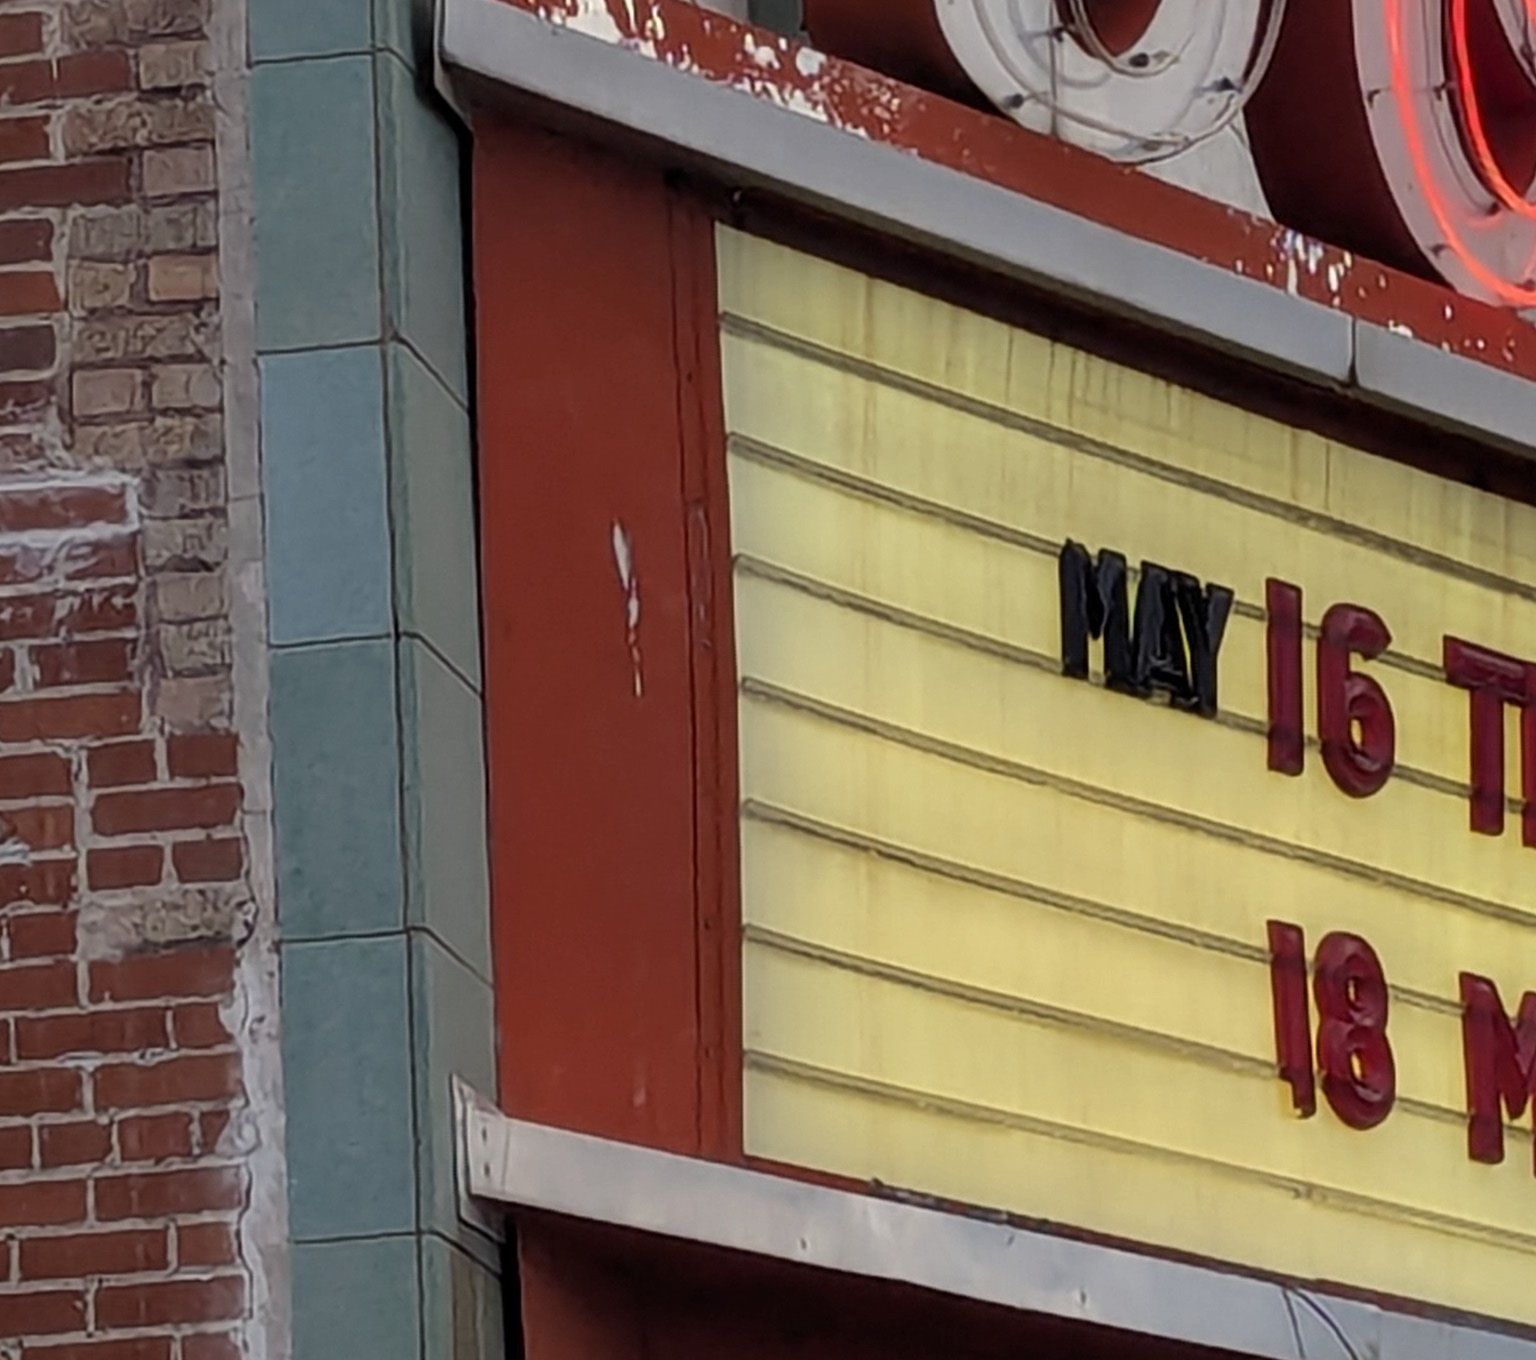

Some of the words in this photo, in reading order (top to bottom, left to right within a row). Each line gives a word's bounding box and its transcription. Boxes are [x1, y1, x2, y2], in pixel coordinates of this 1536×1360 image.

[1058, 538, 1234, 719] MAY
[1265, 577, 1396, 798] 16
[1266, 919, 1396, 1131] 18
